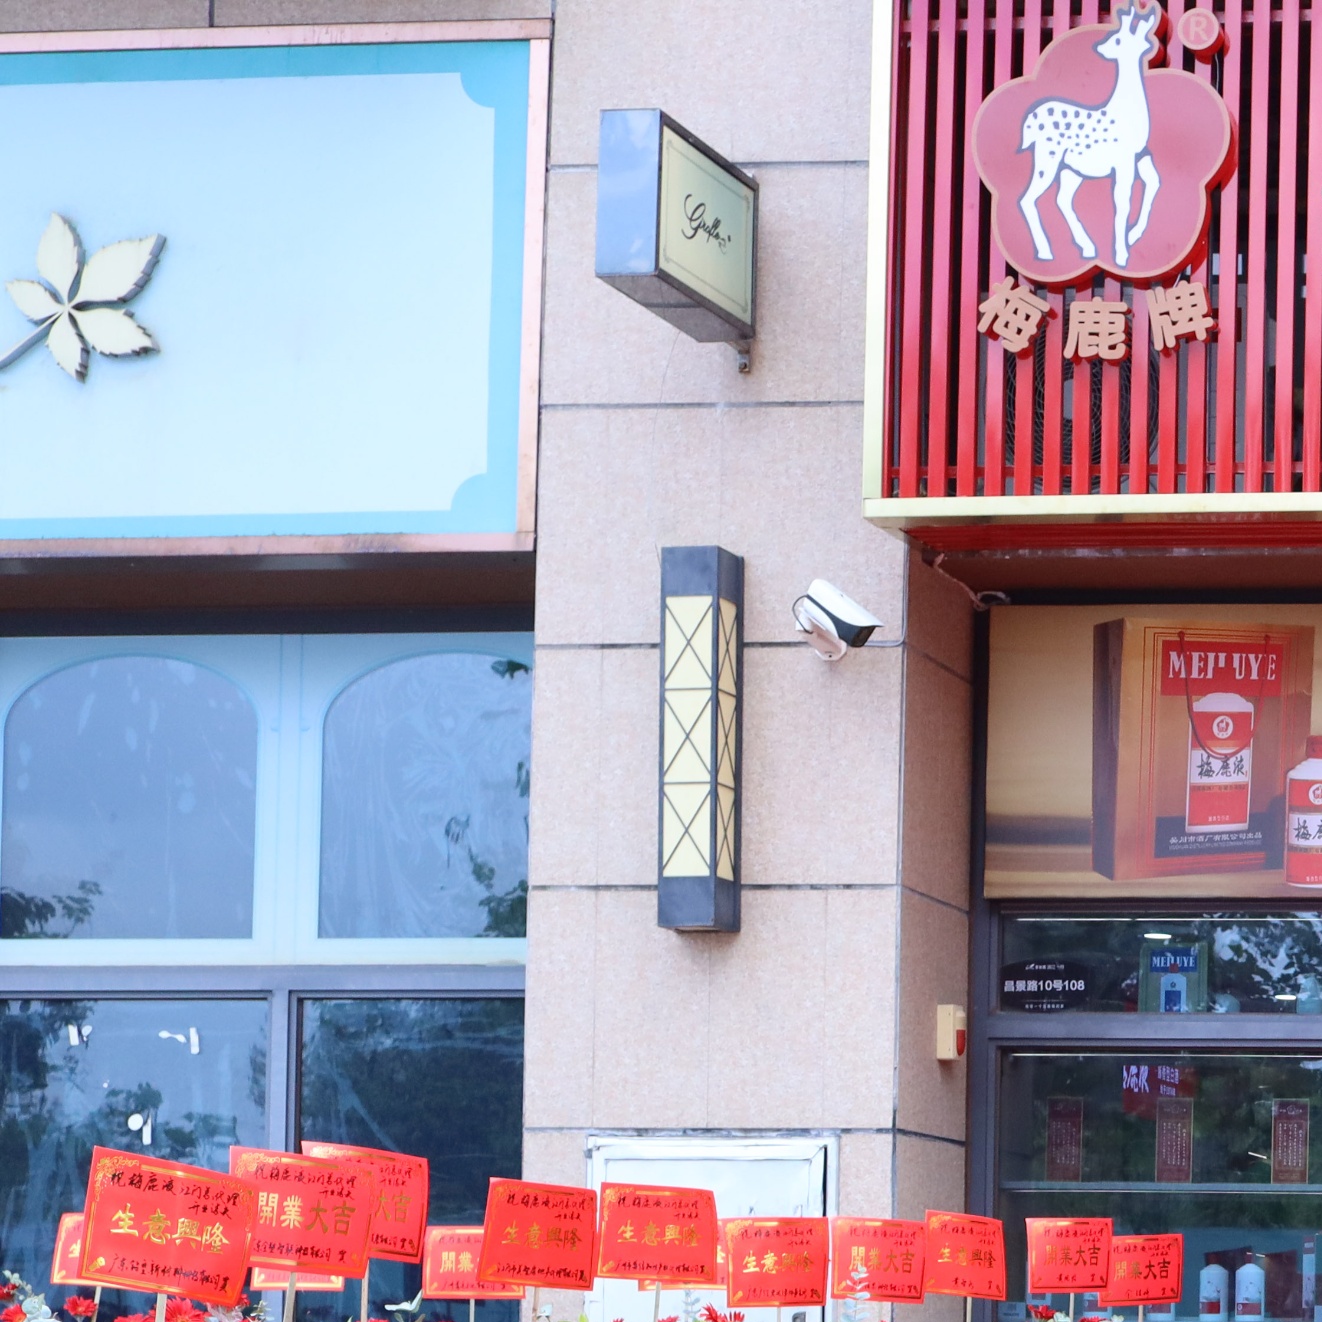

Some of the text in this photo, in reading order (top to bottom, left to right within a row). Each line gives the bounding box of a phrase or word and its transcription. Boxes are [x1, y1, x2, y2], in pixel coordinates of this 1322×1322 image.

[976, 278, 1215, 362] 梅鹿牌
[1196, 753, 1246, 779] 梅鹿液
[1004, 979, 1085, 992] 昌景路10号108
[257, 1191, 357, 1236] 開業大吉
[109, 1202, 231, 1255] 生意興隆
[501, 1220, 583, 1251] 生意興隆
[616, 1219, 702, 1248] 生意興隆
[1043, 1244, 1102, 1267] 開業大吉
[1113, 1258, 1172, 1282] 開業大吉
